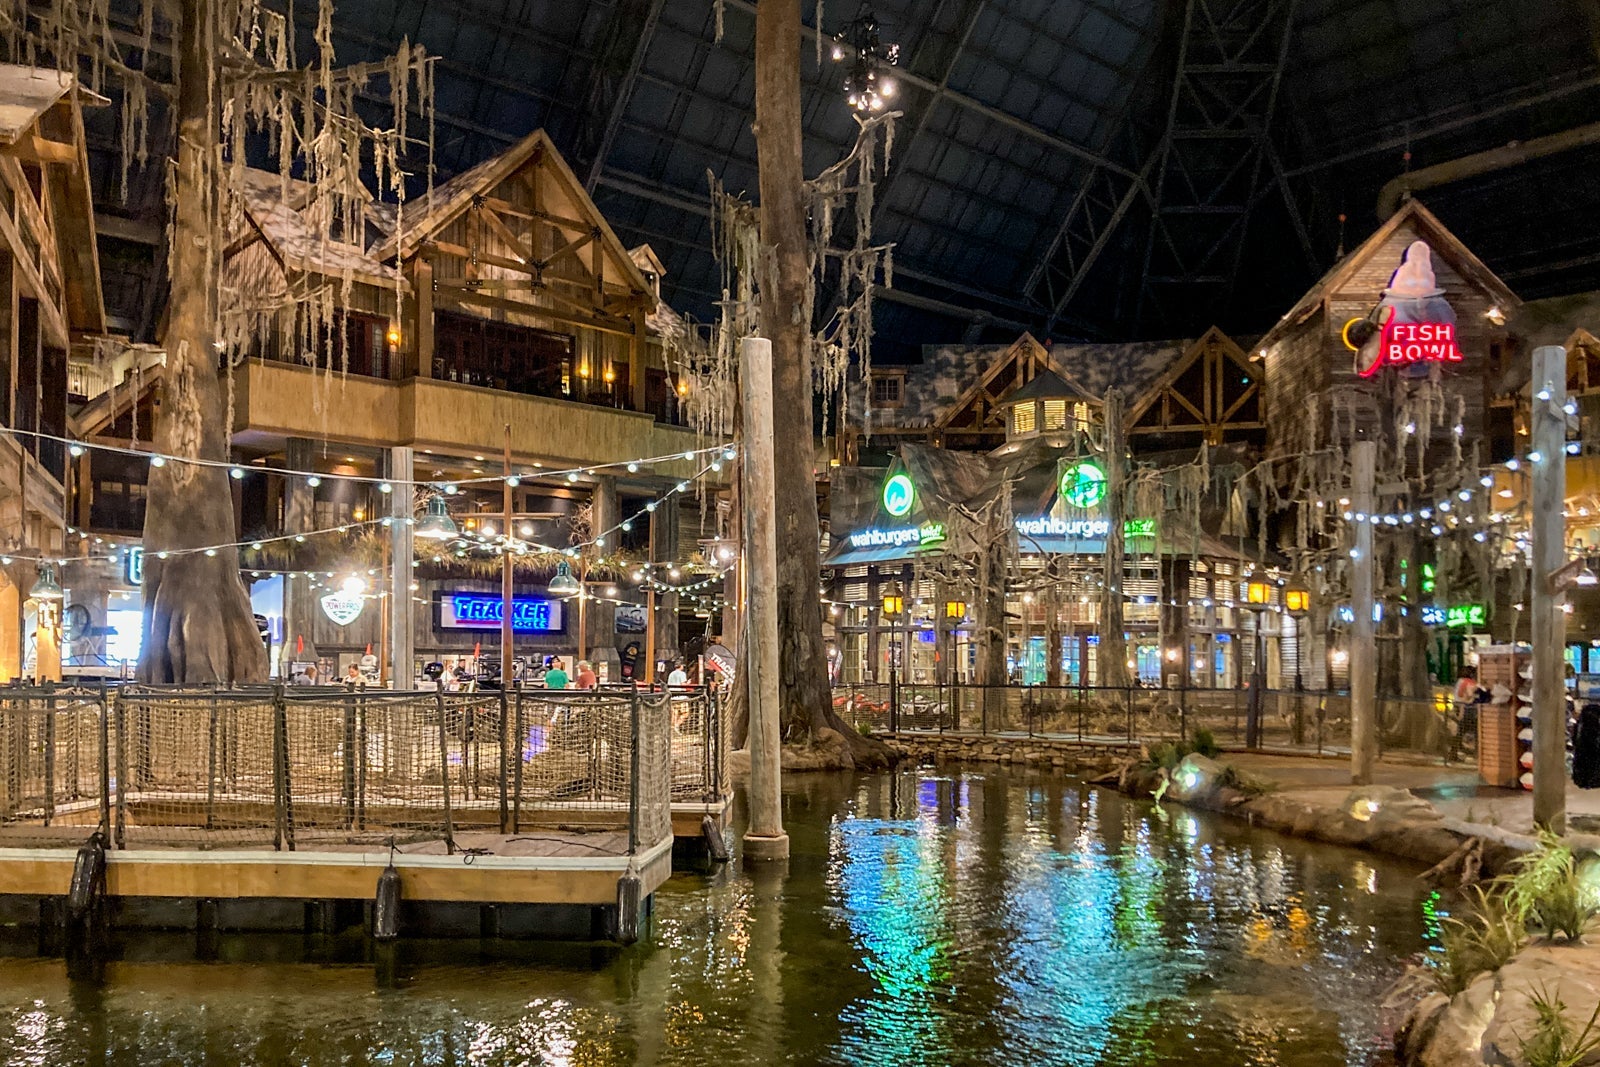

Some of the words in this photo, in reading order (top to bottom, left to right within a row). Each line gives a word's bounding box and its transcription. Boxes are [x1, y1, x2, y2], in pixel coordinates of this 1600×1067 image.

[1393, 325, 1451, 341] FISH
[1389, 344, 1462, 360] BOWL
[1015, 517, 1109, 537] wahlburger
[850, 528, 919, 547] wahlburgers
[455, 597, 549, 620] TRACKER
